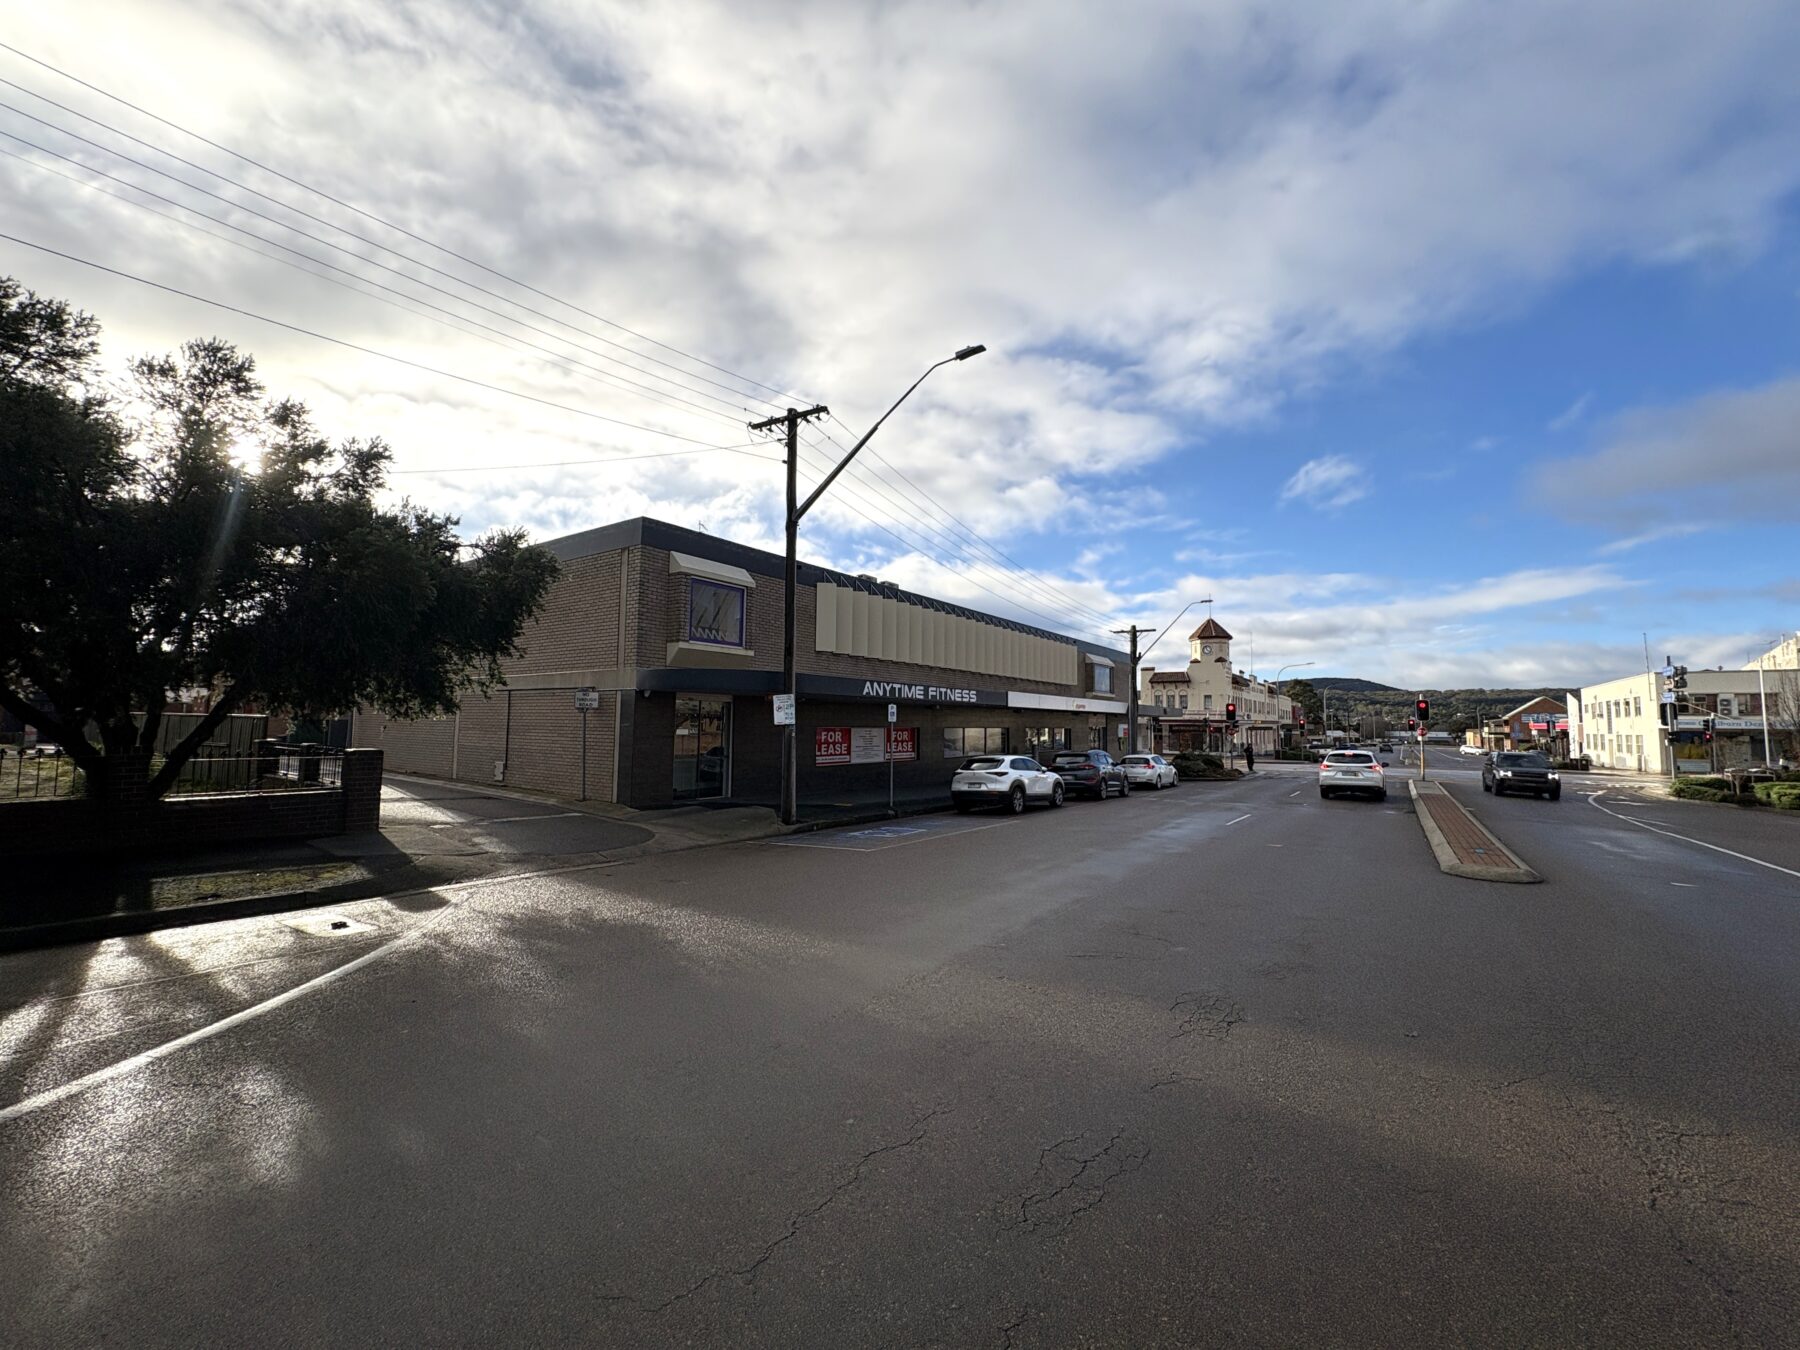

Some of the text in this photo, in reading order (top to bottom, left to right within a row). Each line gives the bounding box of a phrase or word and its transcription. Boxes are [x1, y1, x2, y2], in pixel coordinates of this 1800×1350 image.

[862, 681, 977, 703] ANYTIME FITNESS
[821, 731, 842, 743] FOR
[892, 731, 909, 741] FOR
[815, 743, 848, 756] LEASE
[887, 742, 913, 752] LEASE
